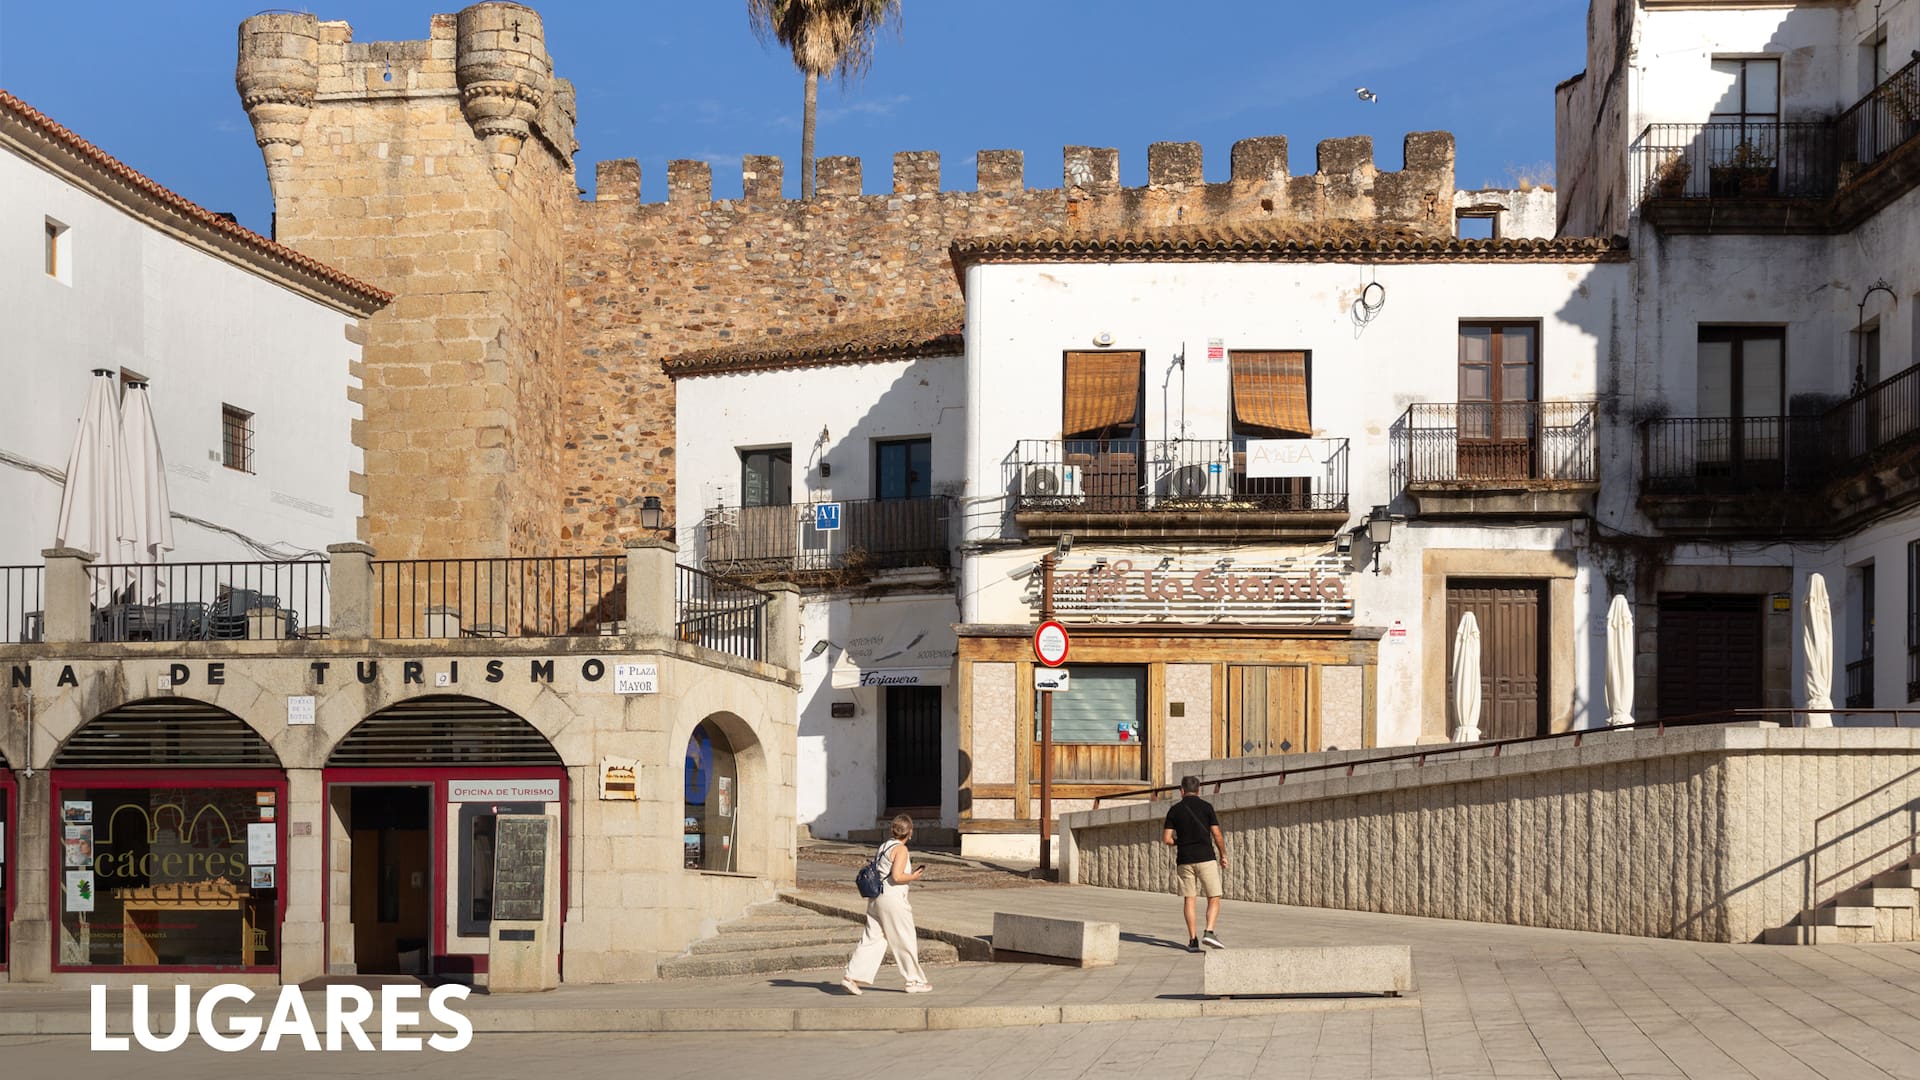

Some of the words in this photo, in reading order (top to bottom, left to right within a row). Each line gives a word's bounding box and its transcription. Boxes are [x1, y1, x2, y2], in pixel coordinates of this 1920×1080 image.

[818, 505, 839, 520] AT
[1193, 568, 1344, 601] Estancia
[170, 663, 226, 685] DE
[311, 658, 606, 684] TURISMO
[629, 666, 657, 676] PLAZA
[619, 680, 652, 691] MAYOR
[860, 671, 919, 687] Forjavera
[454, 787, 493, 796] OFICINA
[496, 788, 508, 796] DE
[511, 787, 554, 796] TURISMO
[94, 850, 246, 877] cáceres
